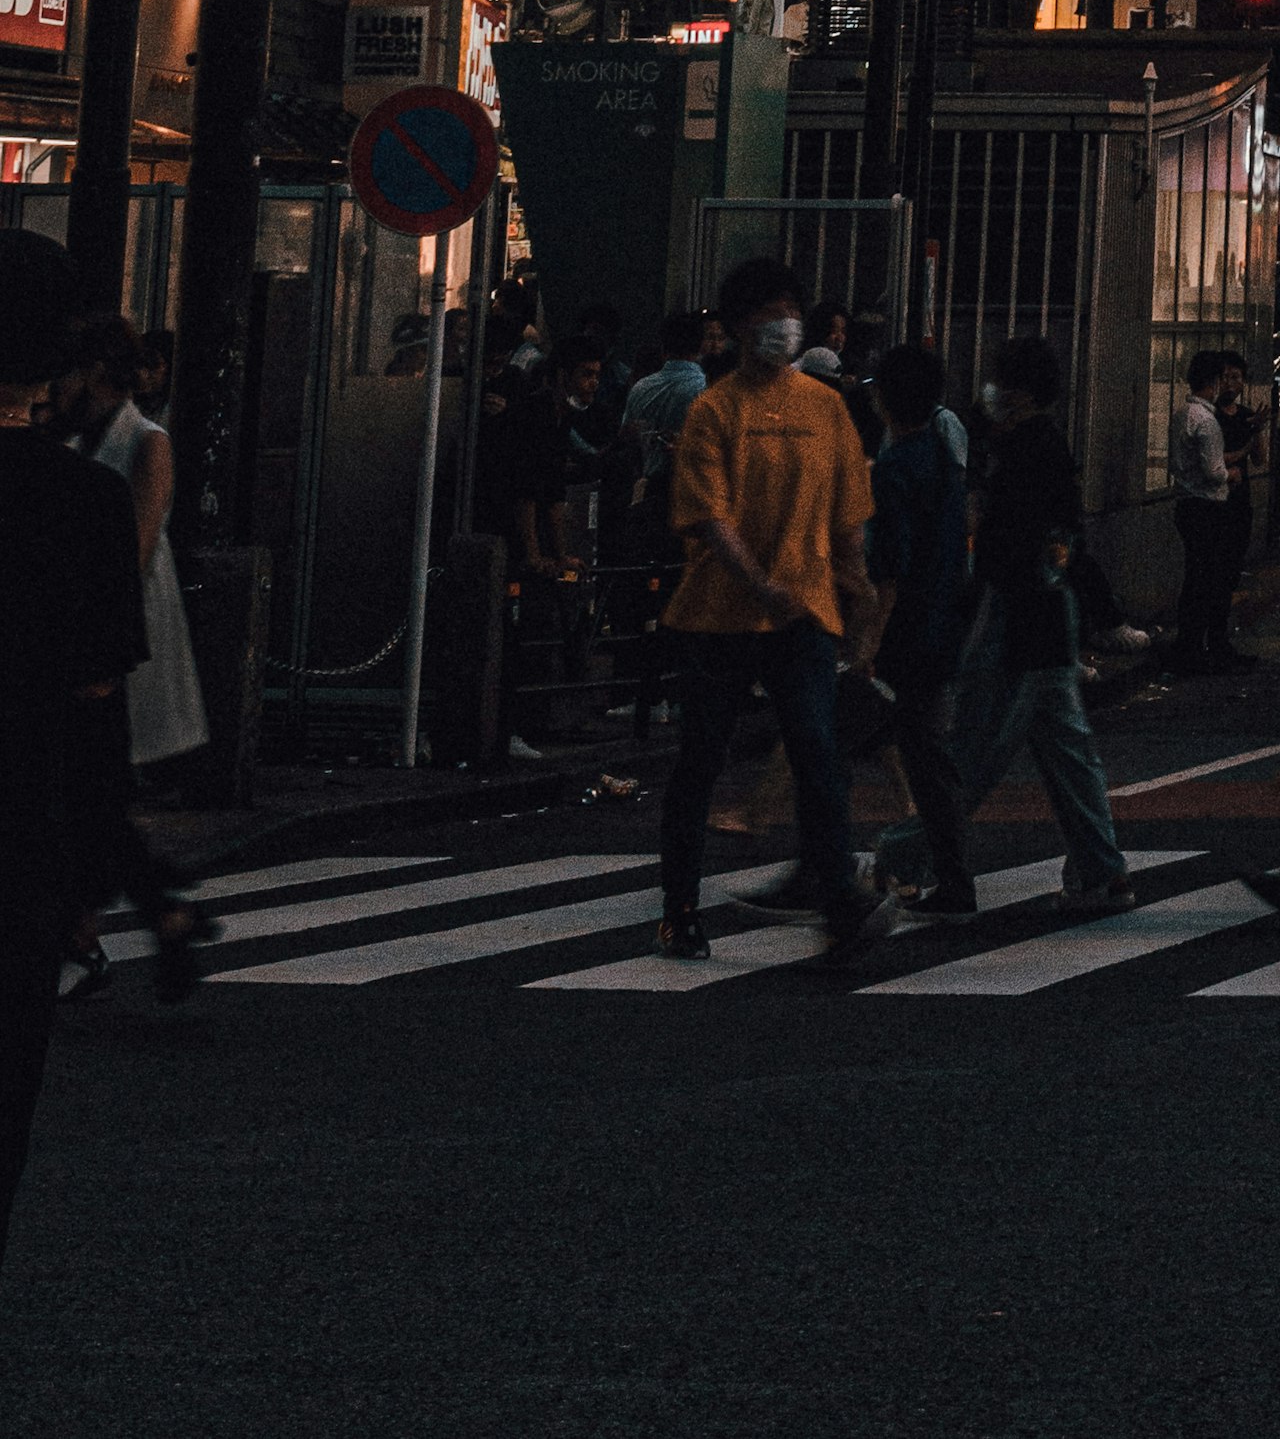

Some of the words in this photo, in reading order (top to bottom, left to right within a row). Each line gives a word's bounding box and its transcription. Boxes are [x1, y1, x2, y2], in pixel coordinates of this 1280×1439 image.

[356, 16, 424, 35] LUSH
[541, 60, 662, 84] SMOKING
[594, 89, 659, 111] AREA
